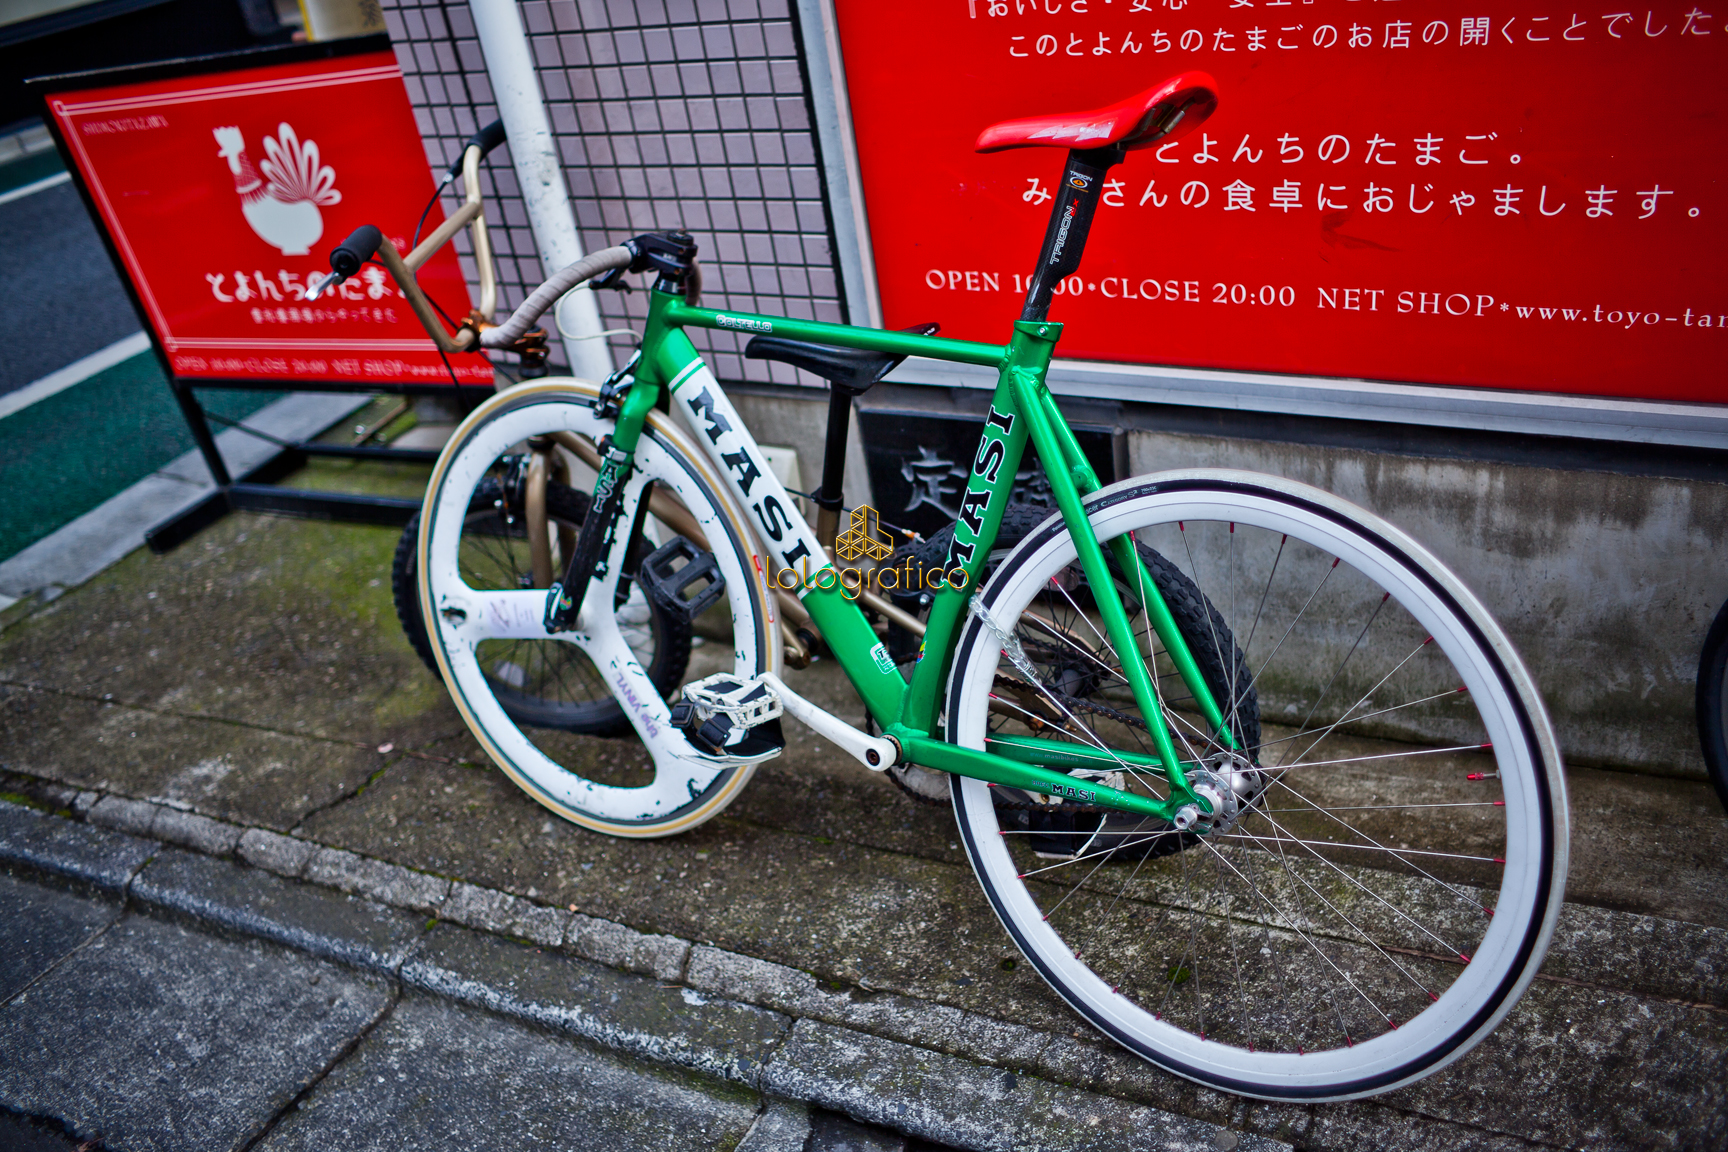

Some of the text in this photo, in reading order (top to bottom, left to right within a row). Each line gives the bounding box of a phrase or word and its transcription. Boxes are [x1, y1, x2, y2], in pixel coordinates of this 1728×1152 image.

[1022, 177, 1700, 220] みさんの食卓におじゃまします。
[1049, 205, 1075, 265] TRIGON
[925, 269, 1000, 292] OPEN
[1213, 283, 1296, 307] 20:00
[1317, 287, 1385, 311] NET
[592, 460, 619, 514] ASI
[687, 385, 812, 570] MASI
[940, 404, 1016, 592] MASI
[1051, 783, 1098, 802] MASI
